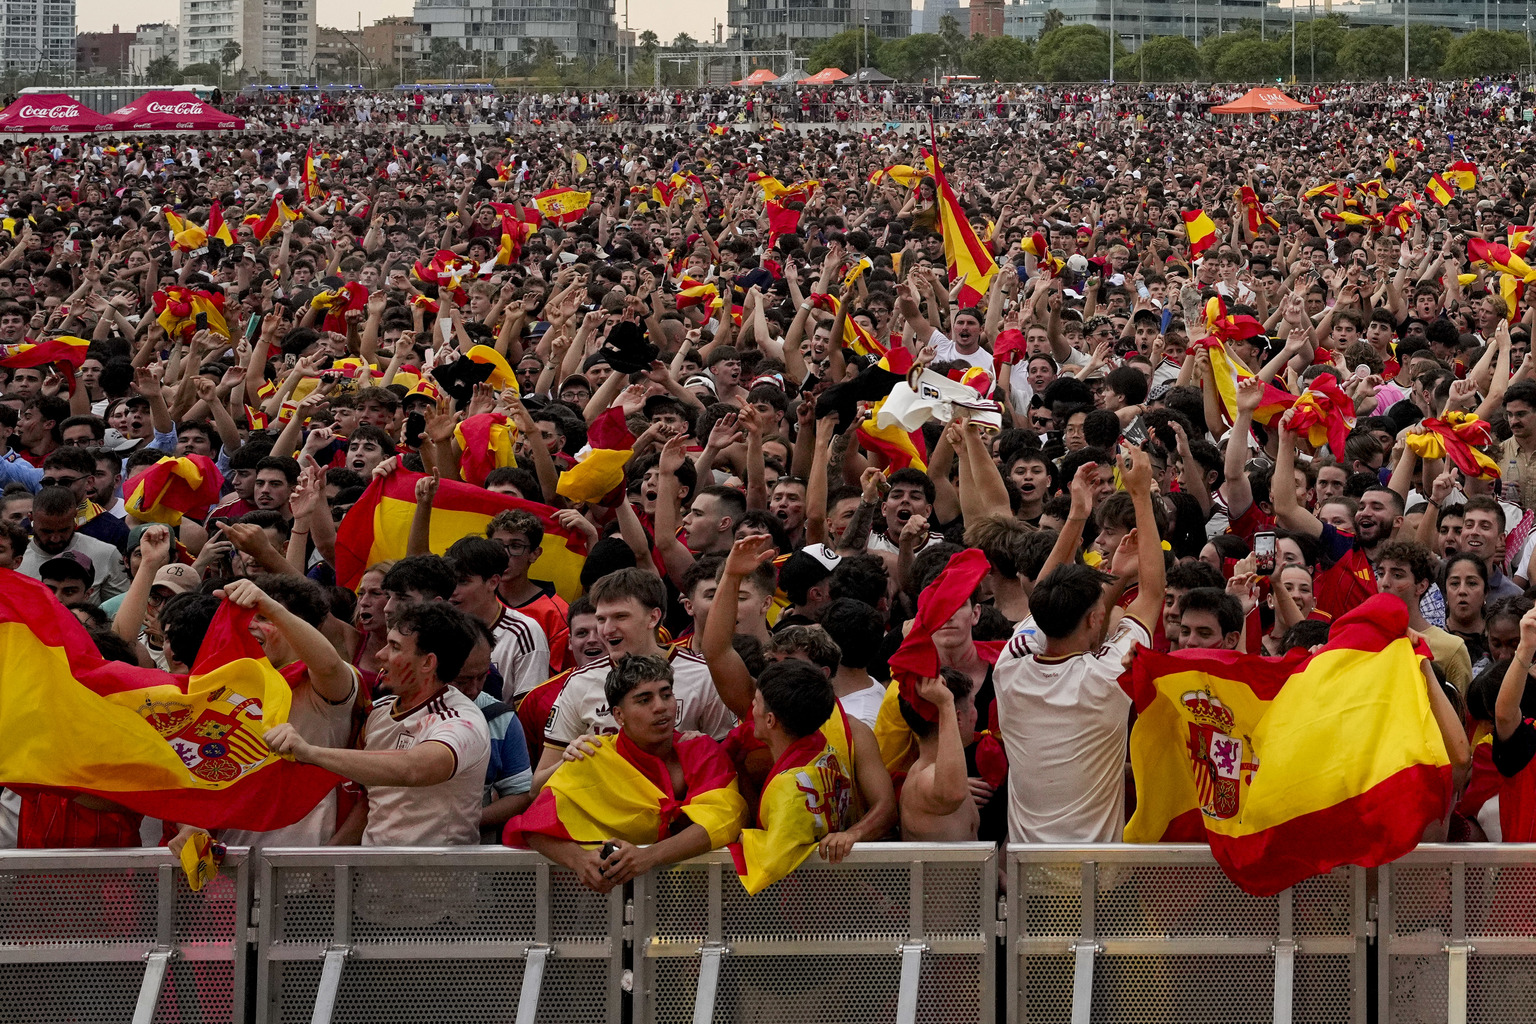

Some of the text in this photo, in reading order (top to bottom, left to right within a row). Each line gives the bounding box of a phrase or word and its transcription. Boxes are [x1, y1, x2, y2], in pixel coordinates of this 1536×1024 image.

[19, 104, 79, 118] Coca-Cola
[147, 101, 203, 114] Coca-Cola
[167, 566, 184, 577] CB
